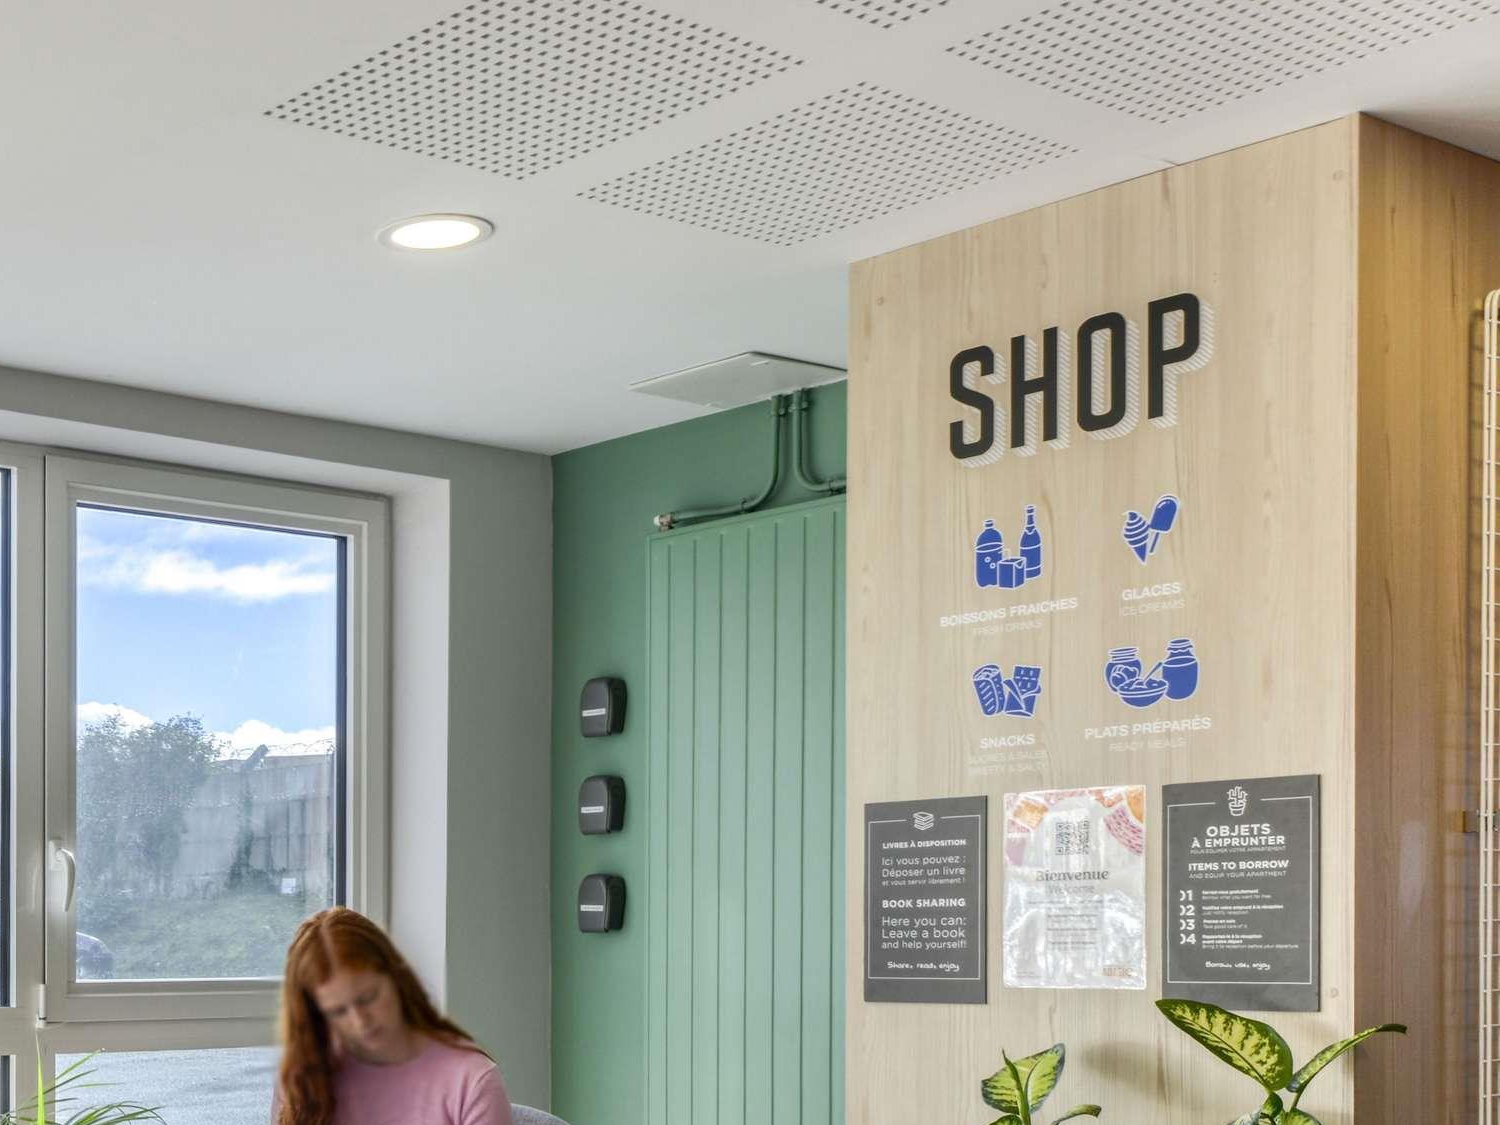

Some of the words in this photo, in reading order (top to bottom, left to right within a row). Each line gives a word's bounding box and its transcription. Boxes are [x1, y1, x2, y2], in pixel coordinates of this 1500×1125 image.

[950, 292, 1208, 463] SHOP
[1123, 582, 1181, 600] GLACES
[940, 608, 1006, 627] BOISSONS
[1010, 597, 1078, 617] FRAICHES
[1085, 724, 1129, 740] PLATS
[1132, 715, 1212, 735] PRÉPARÉS
[979, 734, 1036, 749] SNACKS
[1206, 823, 1271, 837] OBJETS
[882, 841, 908, 849] LIVRES
[917, 839, 966, 848] DISPOSITION
[1205, 836, 1285, 847] EMPRUNTER
[882, 857, 893, 866] Ici
[896, 857, 919, 865] vous
[922, 856, 960, 866] pouvez
[1188, 862, 1219, 871] ITEMS
[1221, 861, 1236, 870] TO
[1239, 860, 1289, 869] BORROW
[882, 868, 924, 878] Déposer
[927, 868, 939, 876] un
[942, 866, 965, 875] livre
[1036, 870, 1109, 882] Bienvenue
[882, 899, 913, 908] BOOK
[916, 898, 966, 907] SHARING
[882, 916, 910, 926] Here
[914, 918, 936, 928] you
[940, 917, 966, 926] can:
[882, 928, 918, 938] Leave
[921, 930, 929, 938] a
[933, 928, 965, 938] book
[881, 940, 899, 949] and
[902, 940, 922, 950] help
[925, 940, 966, 950] yourself!
[938, 962, 960, 972] enjoy
[1252, 961, 1270, 971] enjoy
